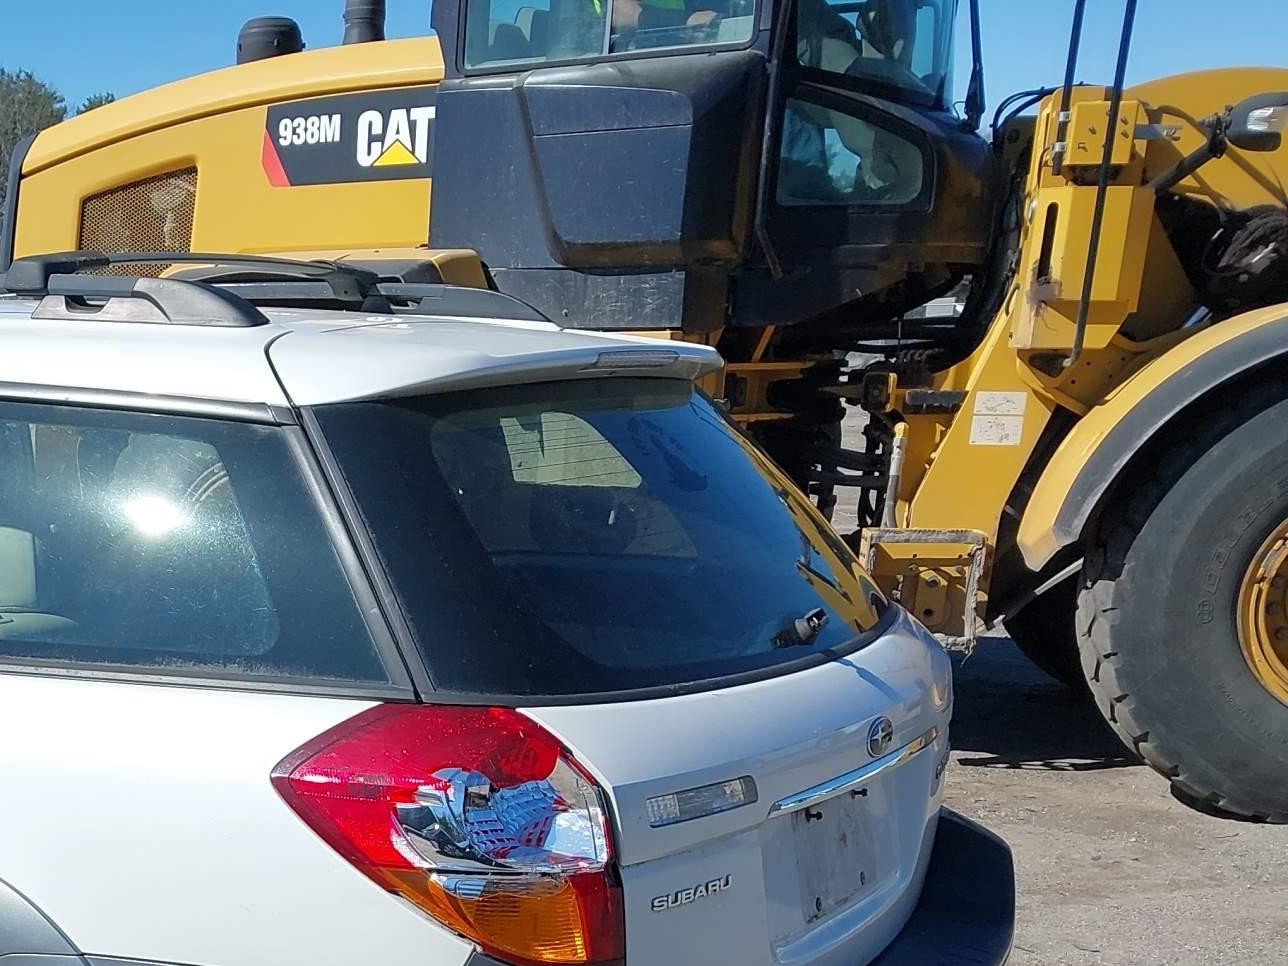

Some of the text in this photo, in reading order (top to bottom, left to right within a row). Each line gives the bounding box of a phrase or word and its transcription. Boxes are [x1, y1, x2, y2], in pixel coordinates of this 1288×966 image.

[278, 105, 436, 167] 938M CAT
[651, 873, 733, 912] SUBARU
